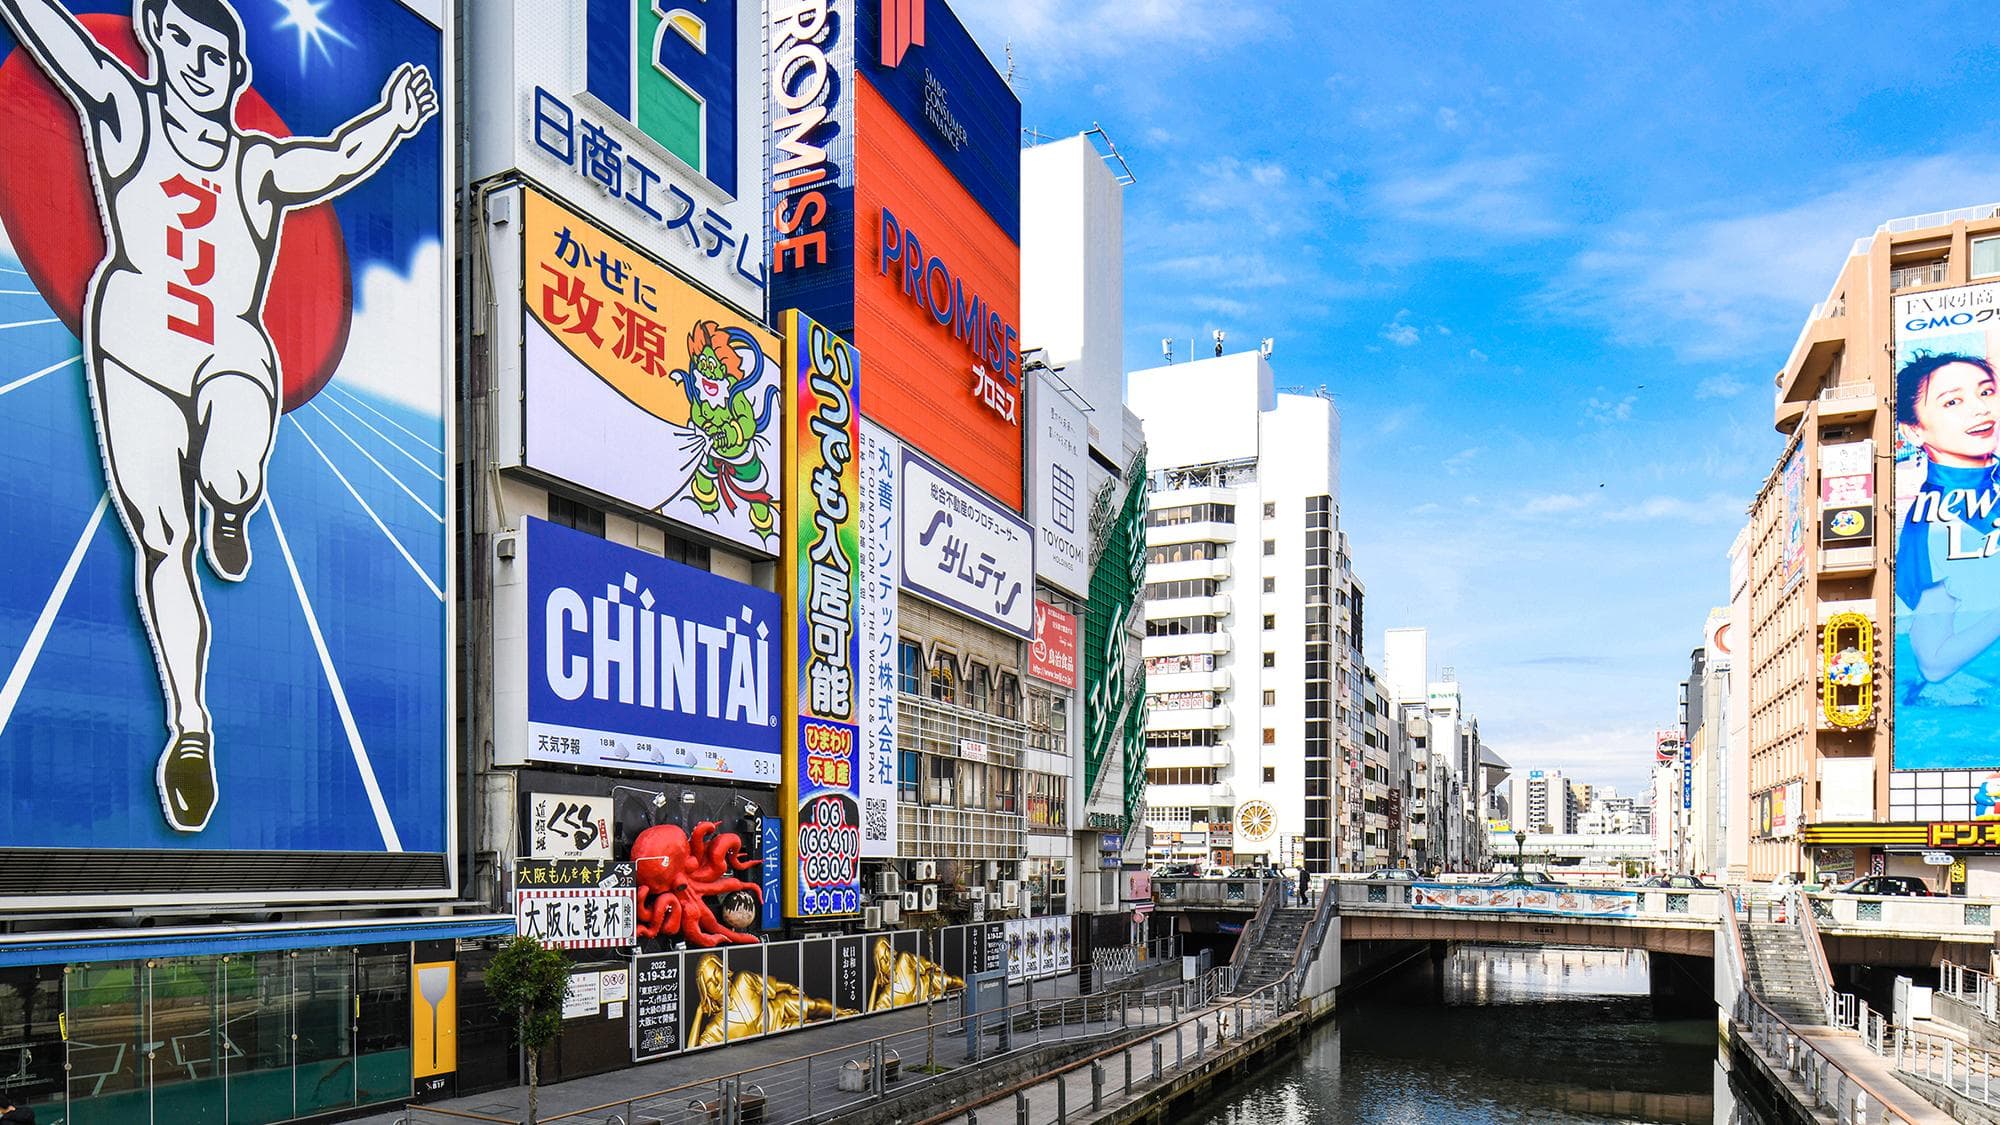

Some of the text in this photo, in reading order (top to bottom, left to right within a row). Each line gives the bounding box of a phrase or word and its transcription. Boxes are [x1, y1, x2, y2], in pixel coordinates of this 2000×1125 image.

[925, 67, 947, 105] SMBC
[925, 85, 968, 147] CONSUMER
[925, 101, 960, 152] FINANCE
[534, 85, 766, 290] 日商エステム
[159, 173, 222, 346] グリコ
[553, 226, 658, 313] かぜに
[880, 206, 1017, 386] PROMISE
[540, 261, 667, 378] 改源
[972, 364, 1018, 426] プロミス
[868, 437, 875, 462] BE
[811, 325, 850, 715] いつでも入居可能
[930, 481, 1019, 542] 総合不動産のプロデューサー
[938, 535, 1007, 596] サムティ
[868, 581, 875, 603] OF
[878, 446, 893, 785] 丸善インテック株式会社
[546, 572, 769, 727] CHINTAI
[538, 734, 581, 755] 天気予報
[806, 725, 853, 757] ひまわり
[808, 756, 851, 787] 不動産
[547, 802, 598, 850] くくる
[755, 817, 762, 849] 2F
[817, 800, 841, 827] 06
[519, 865, 605, 885] 大阪もんを食す
[619, 876, 634, 887] 2F
[807, 855, 853, 882] 6304
[524, 898, 620, 939] 大阪に乾杯
[803, 889, 858, 914] 年中無休
[639, 968, 678, 983] 3.19-3.27
[650, 960, 667, 970] 2022
